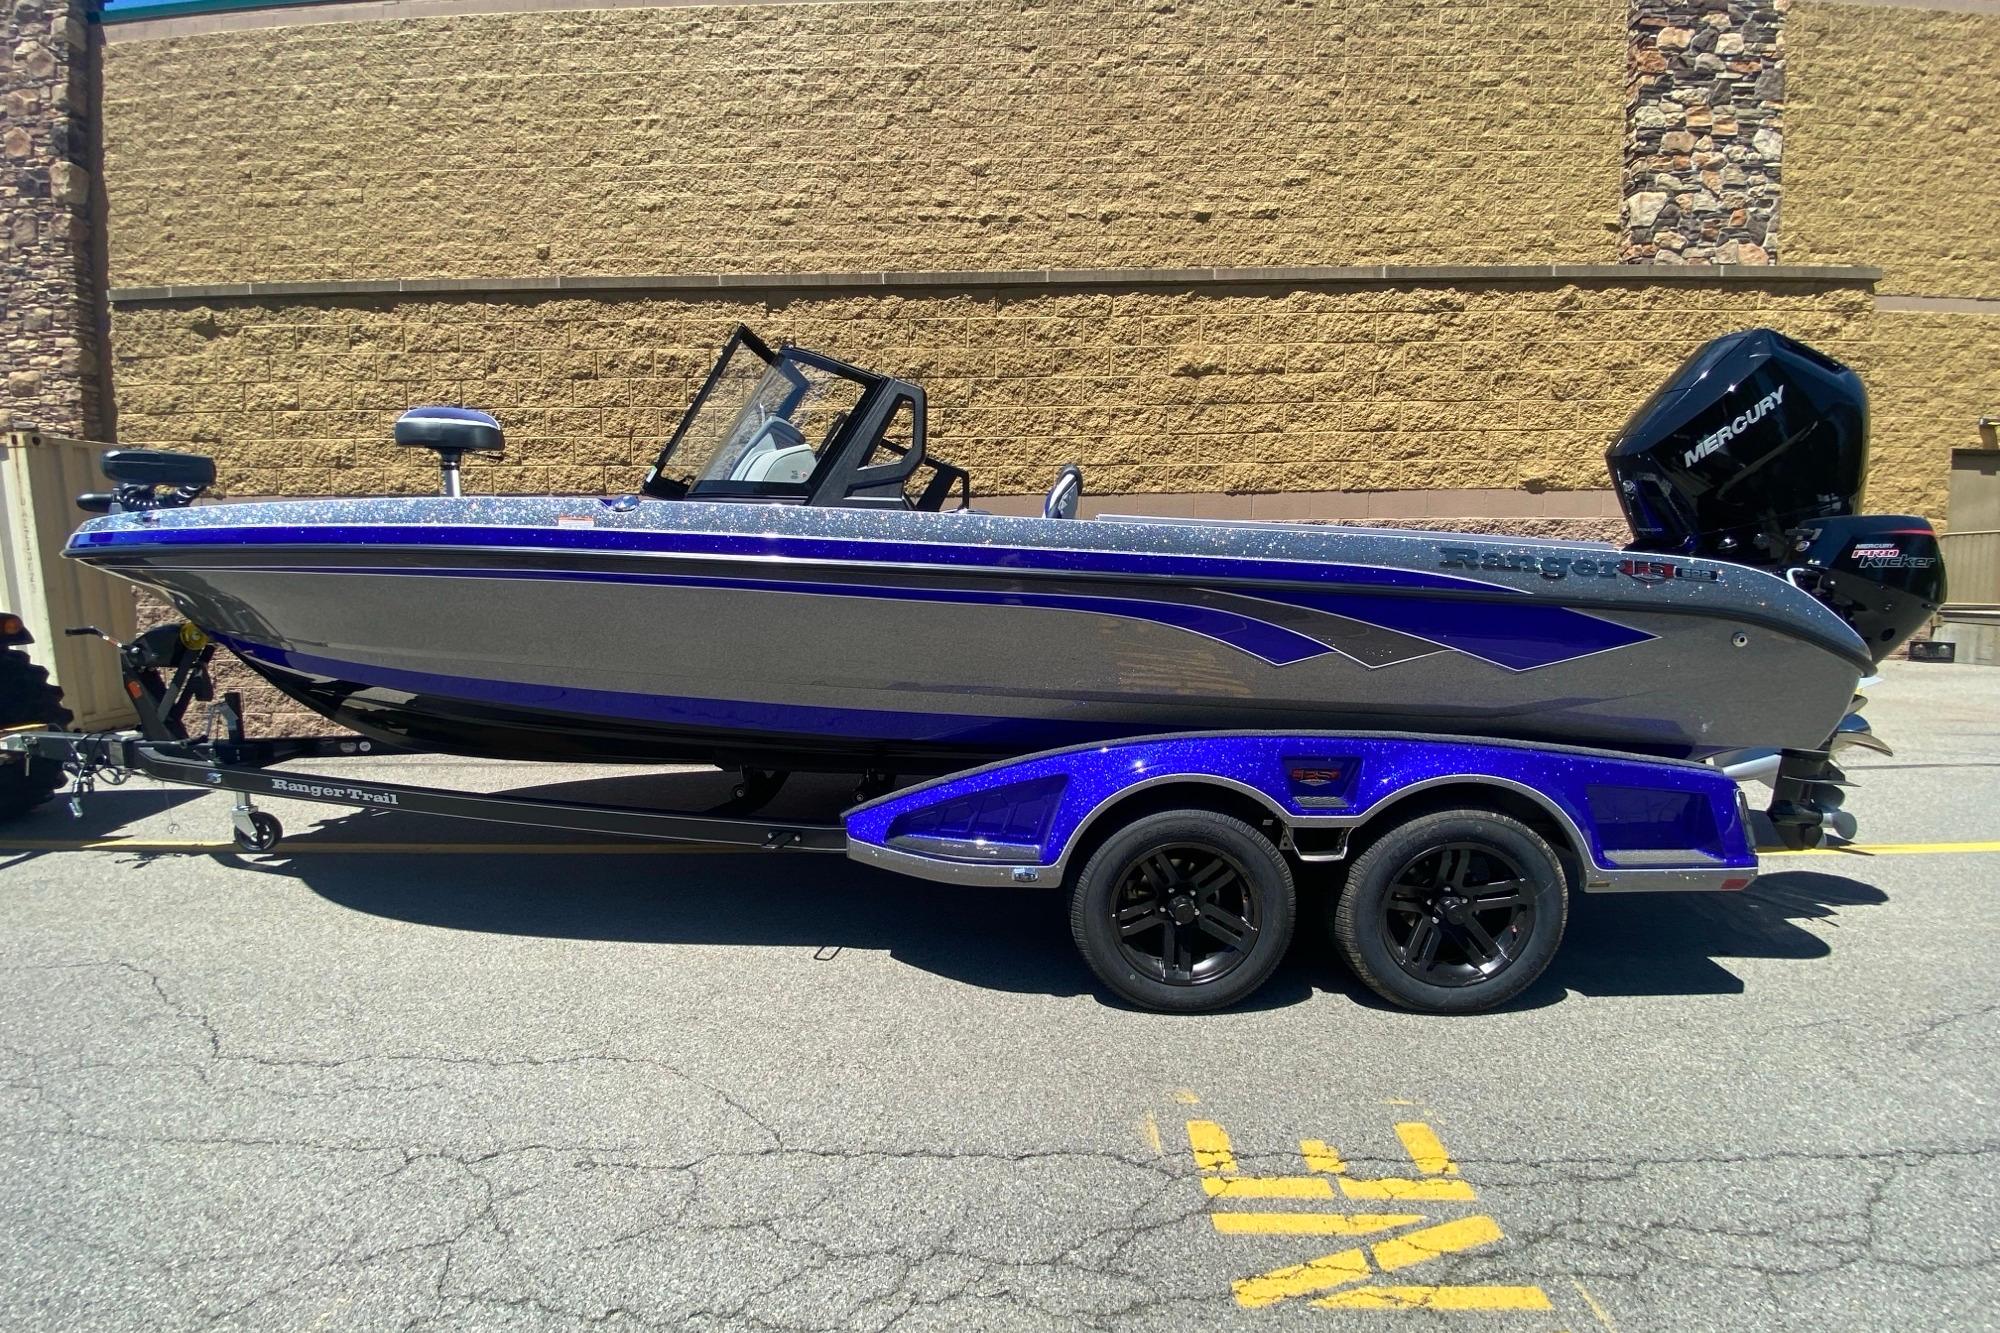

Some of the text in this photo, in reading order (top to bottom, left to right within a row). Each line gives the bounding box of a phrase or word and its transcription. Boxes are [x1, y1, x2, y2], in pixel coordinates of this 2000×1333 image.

[1684, 384, 1785, 468] MERCURY
[1438, 547, 1621, 579] Ranger
[1851, 549, 1900, 558] PRO
[271, 778, 399, 805] Ranger Trail
